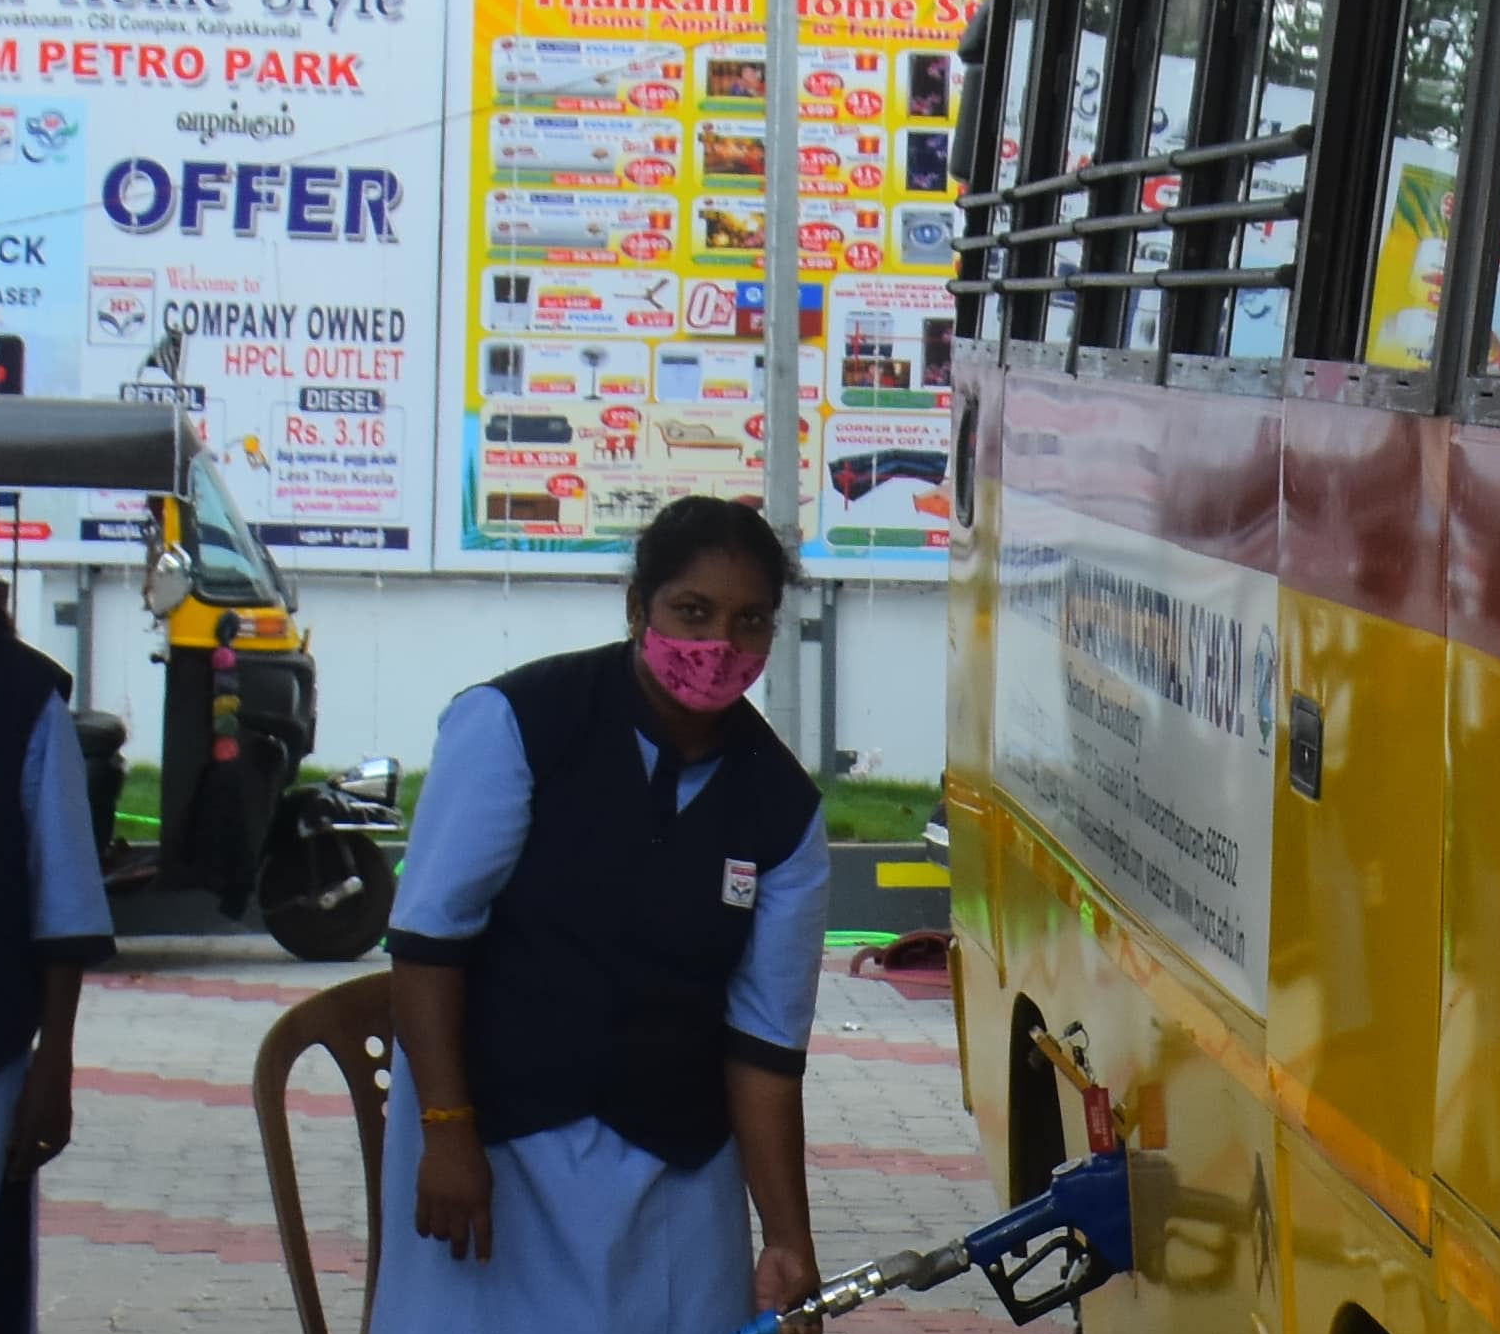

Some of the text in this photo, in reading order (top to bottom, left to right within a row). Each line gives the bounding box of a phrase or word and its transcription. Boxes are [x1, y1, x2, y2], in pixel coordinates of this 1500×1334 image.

[38, 38, 207, 86] PETRO
[224, 46, 363, 92] PARK
[102, 156, 404, 243] OFFER
[165, 264, 239, 293] Welcome
[243, 275, 261, 293] to
[163, 301, 406, 343] COMPANY OWNED
[223, 343, 406, 380] HPCL OUTLET
[304, 388, 379, 412] DIESEL
[285, 415, 385, 448] Rs. 3.16
[1186, 602, 1245, 739] SCHOOL
